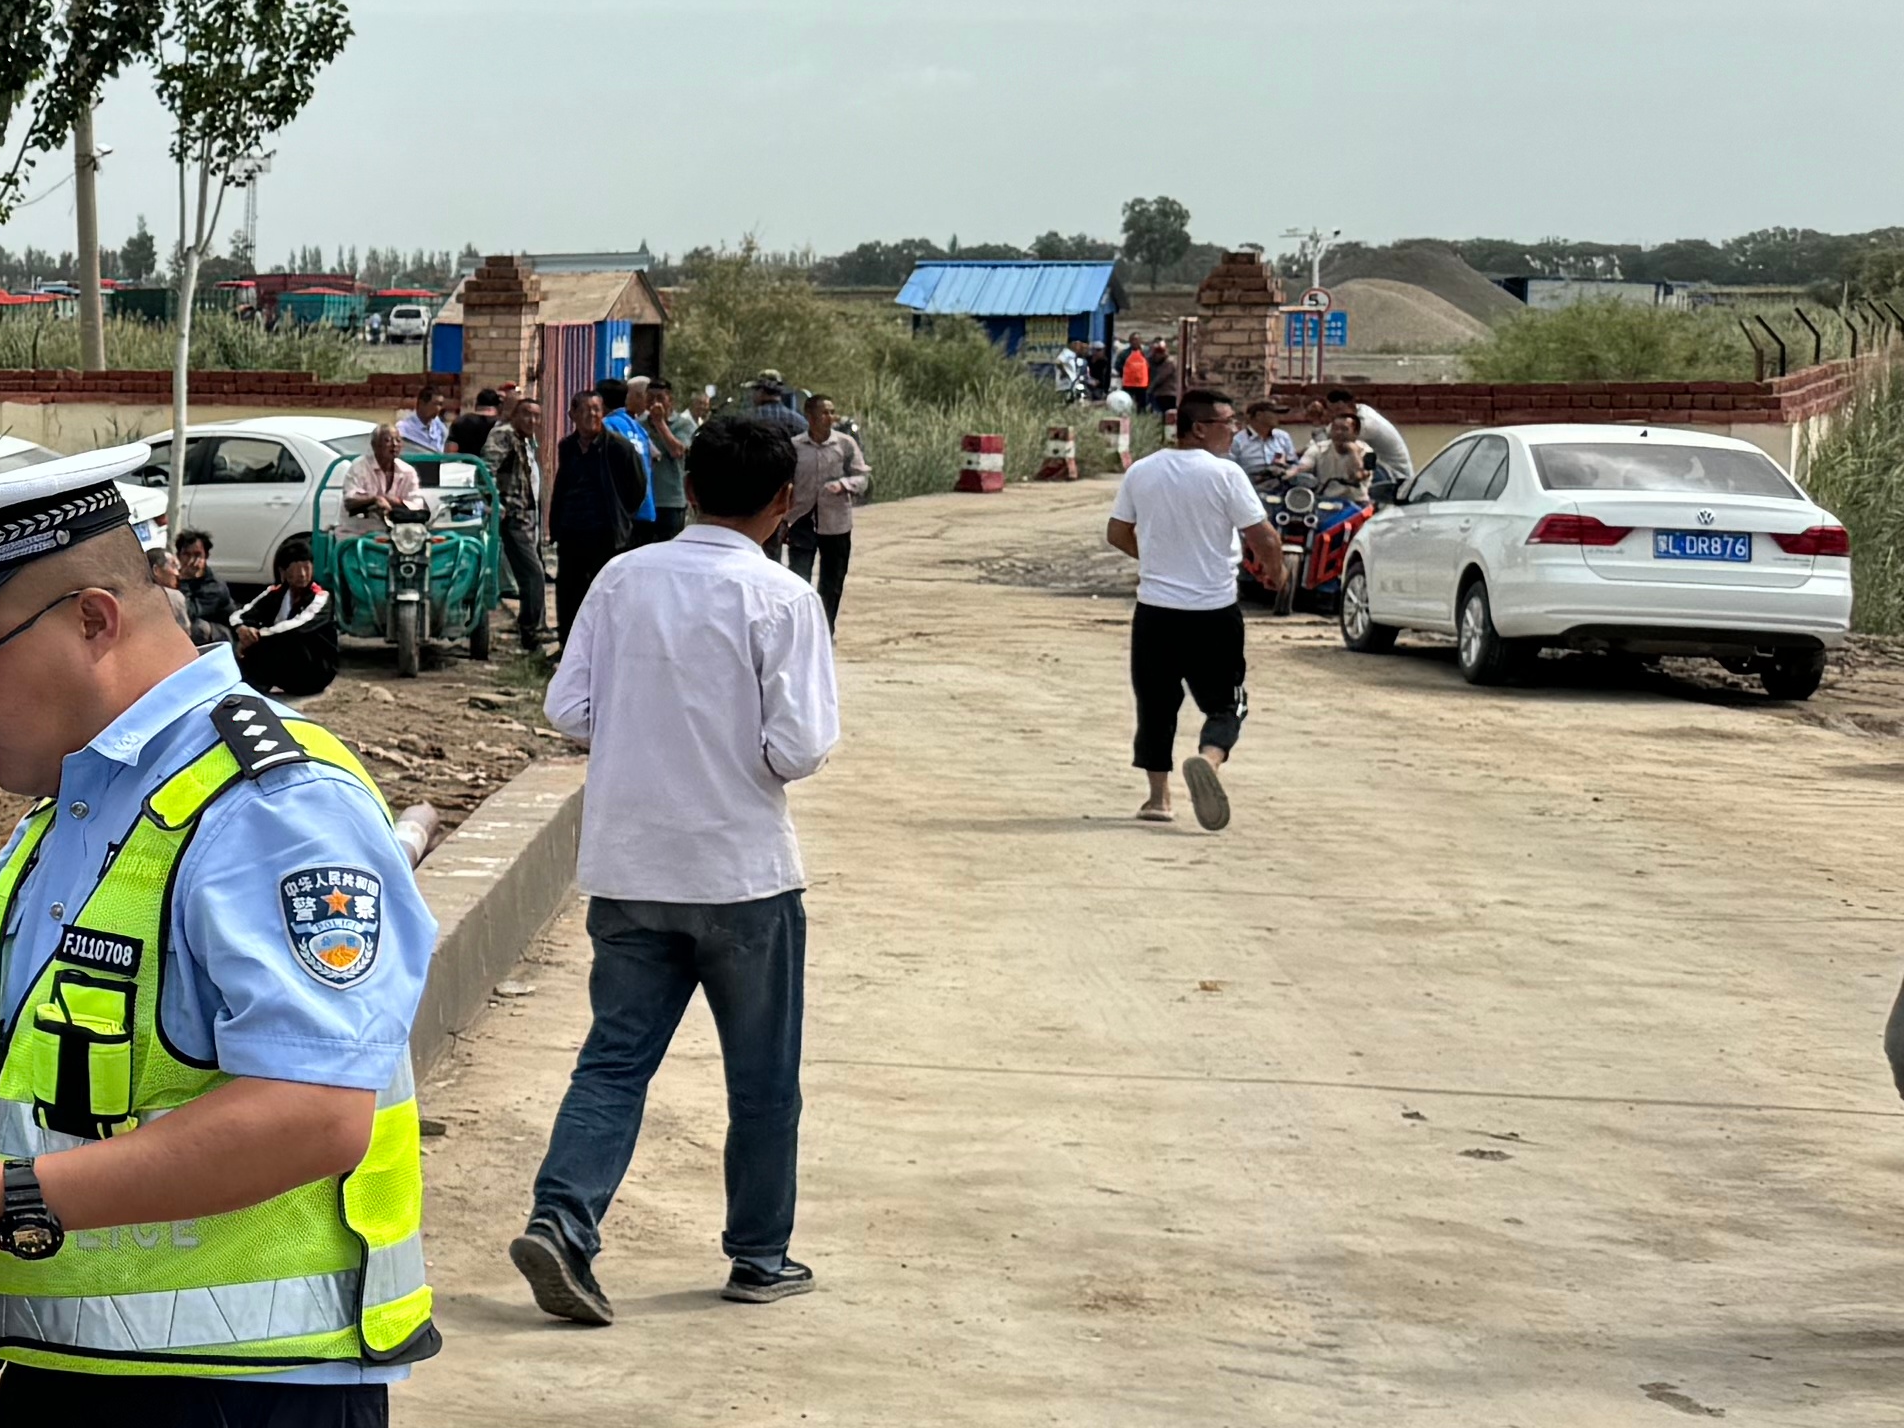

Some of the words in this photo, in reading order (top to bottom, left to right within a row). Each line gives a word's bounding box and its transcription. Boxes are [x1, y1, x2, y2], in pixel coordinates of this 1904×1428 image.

[284, 870, 379, 898] 中华人民共和国
[62, 932, 133, 966] FJ110708
